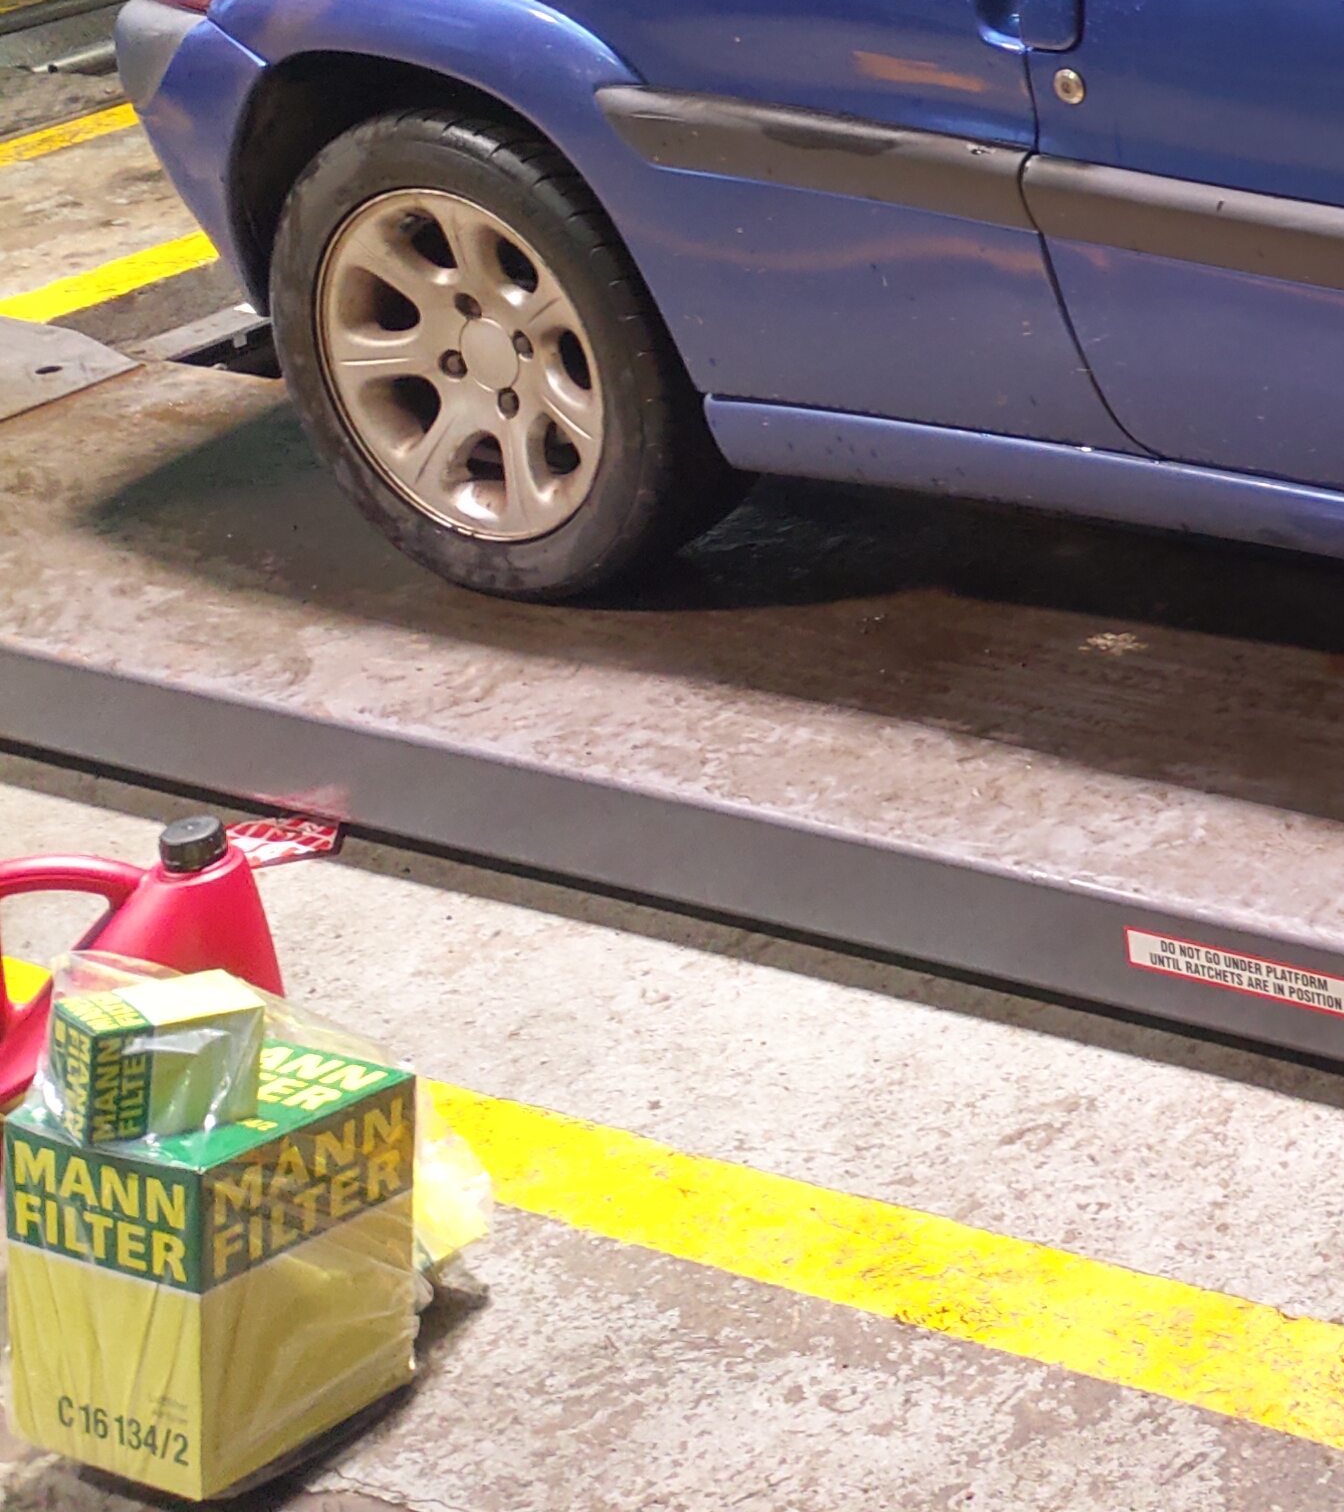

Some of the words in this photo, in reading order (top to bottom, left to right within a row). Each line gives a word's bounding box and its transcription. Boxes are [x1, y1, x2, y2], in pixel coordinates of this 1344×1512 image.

[1150, 952, 1182, 972] UNTIL
[1185, 960, 1243, 986] RATCHETS
[1247, 975, 1269, 993] ARE
[1273, 982, 1284, 996] IN
[1288, 986, 1342, 1011] POSITION
[1160, 940, 1176, 955] DO
[1179, 945, 1201, 961] NOT
[1205, 951, 1220, 966] GO
[1223, 956, 1263, 975] UNDER
[1266, 965, 1328, 992] PLATFORM
[92, 1039, 122, 1142] MANN
[259, 1046, 388, 1092] ANN
[14, 1140, 186, 1230] MANN
[213, 1097, 403, 1226] MANN
[15, 1191, 187, 1283] FILTER
[213, 1148, 401, 1279] FILTER
[58, 1395, 74, 1428] C
[79, 1403, 108, 1439] 16
[114, 1415, 189, 1466] 134/2
